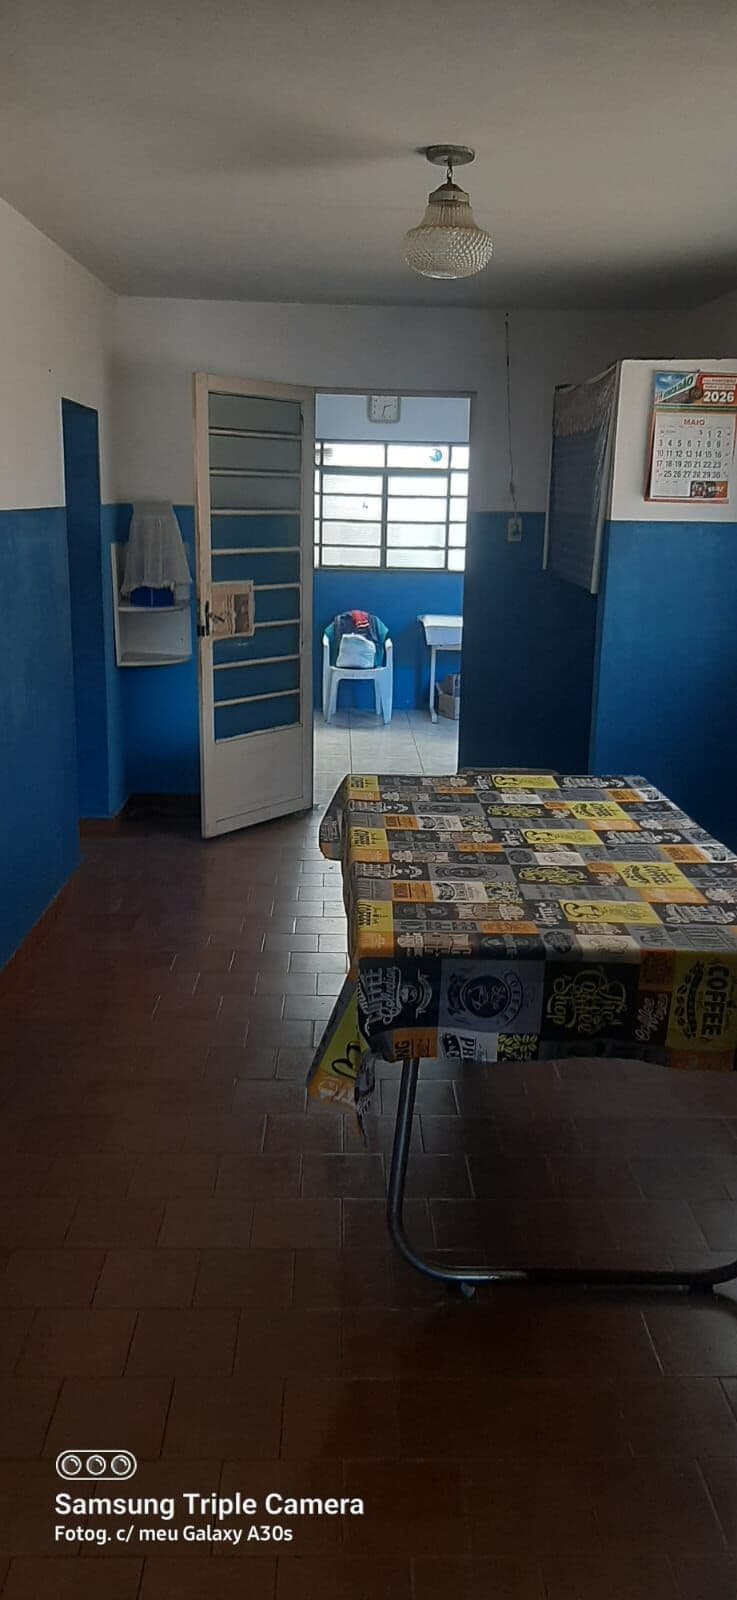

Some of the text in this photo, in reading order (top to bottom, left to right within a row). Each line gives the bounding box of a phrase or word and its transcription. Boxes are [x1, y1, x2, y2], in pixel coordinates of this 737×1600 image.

[703, 391, 735, 403] 2026
[684, 418, 706, 426] MAIO
[708, 430, 722, 438] 1 2
[702, 965, 730, 1036] COFFEE
